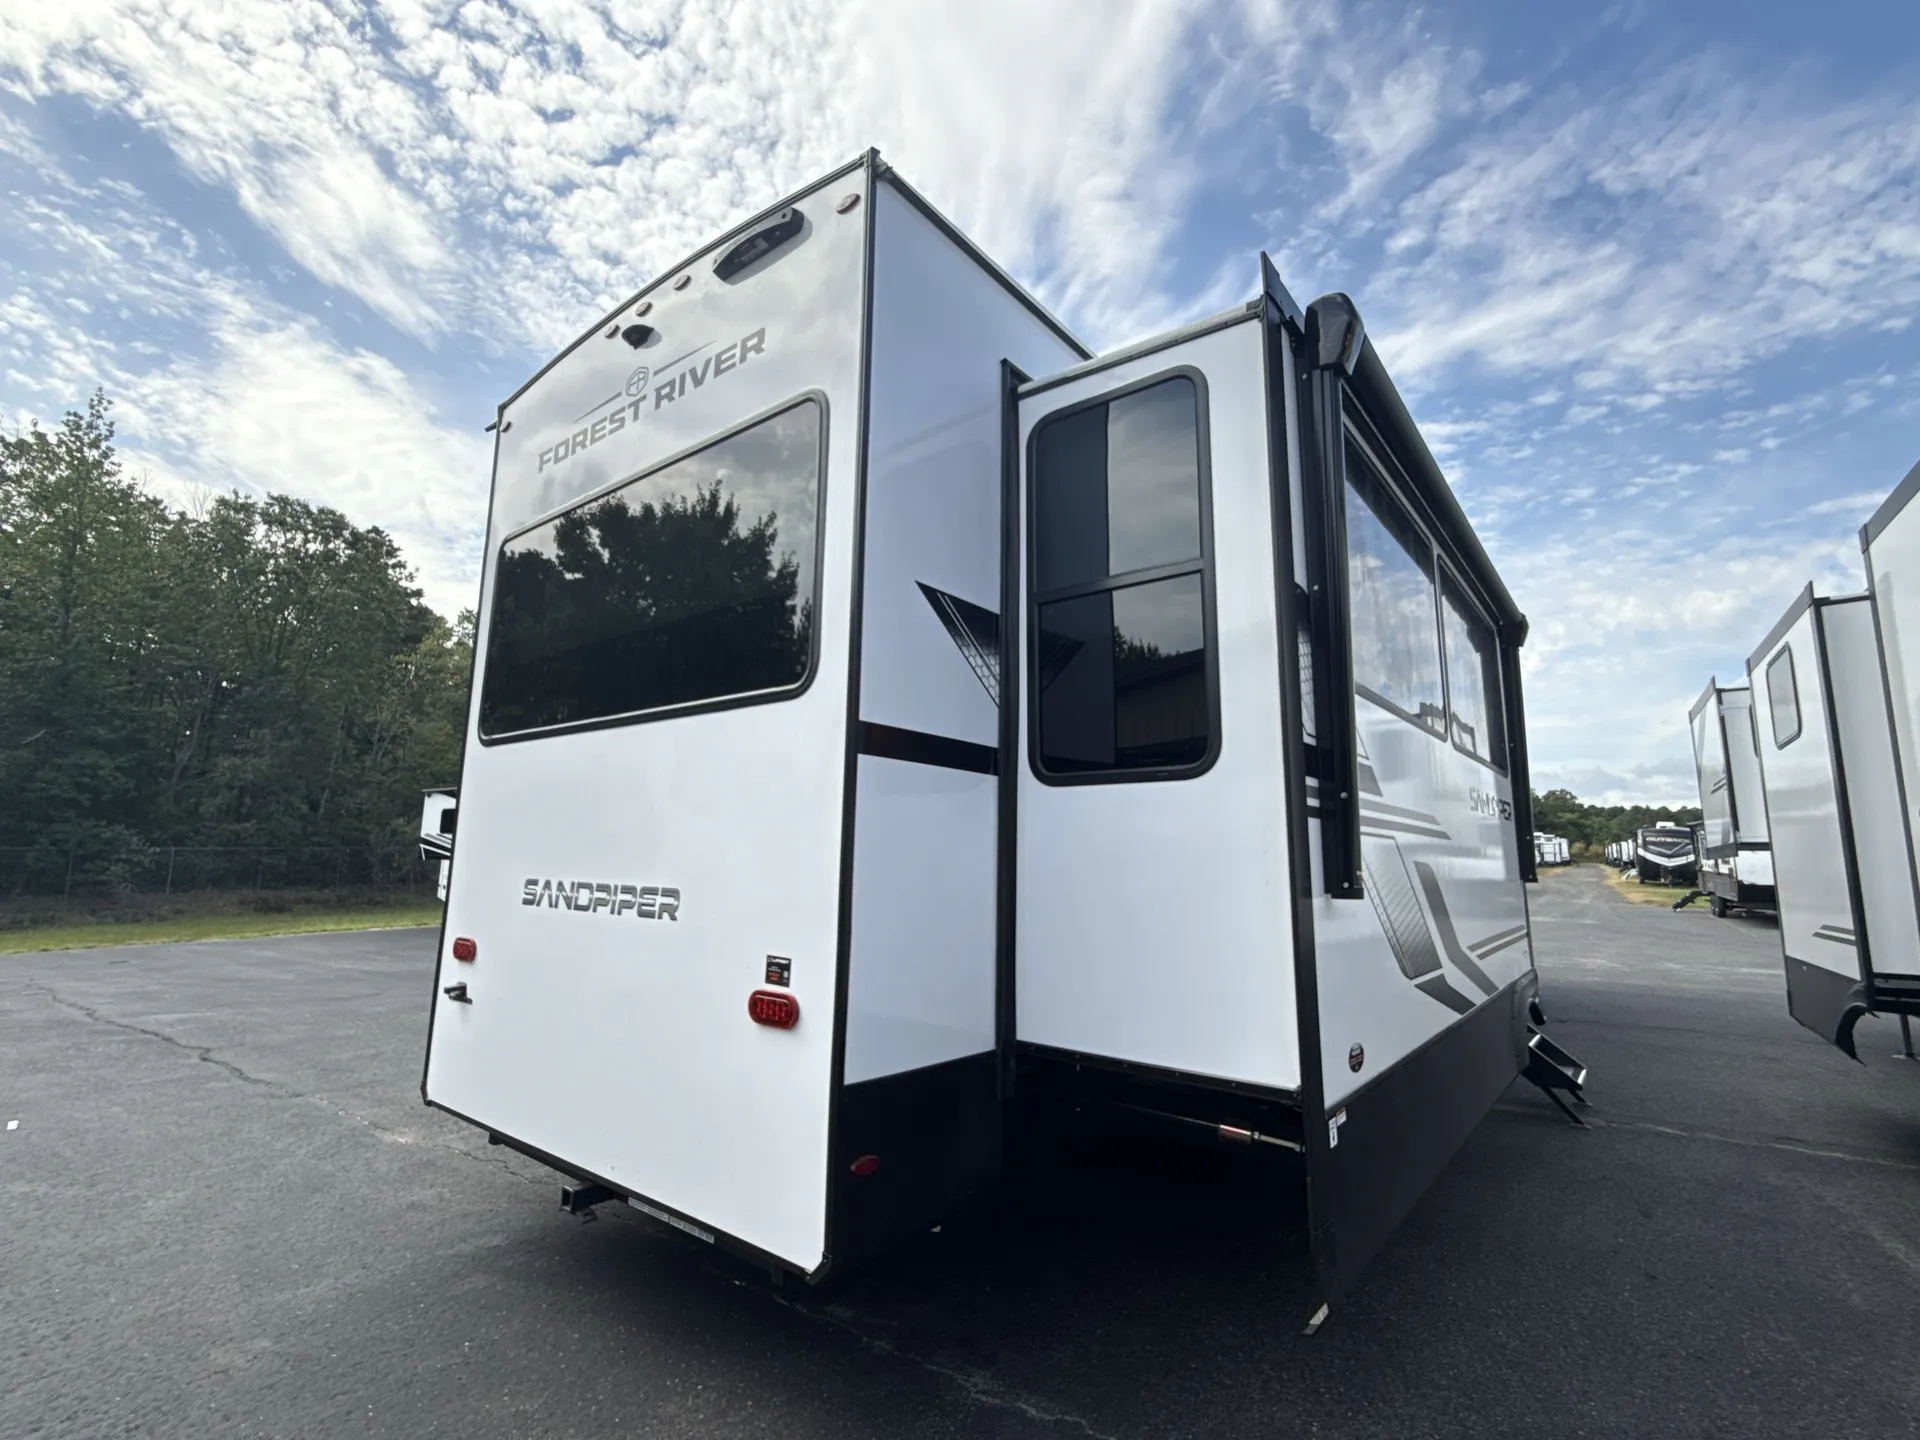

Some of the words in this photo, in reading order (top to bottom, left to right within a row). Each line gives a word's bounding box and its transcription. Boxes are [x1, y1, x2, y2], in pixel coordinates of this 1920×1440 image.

[538, 394, 647, 474] FOREST
[654, 327, 766, 411] RIVER
[522, 878, 681, 921] SANDPIPER
